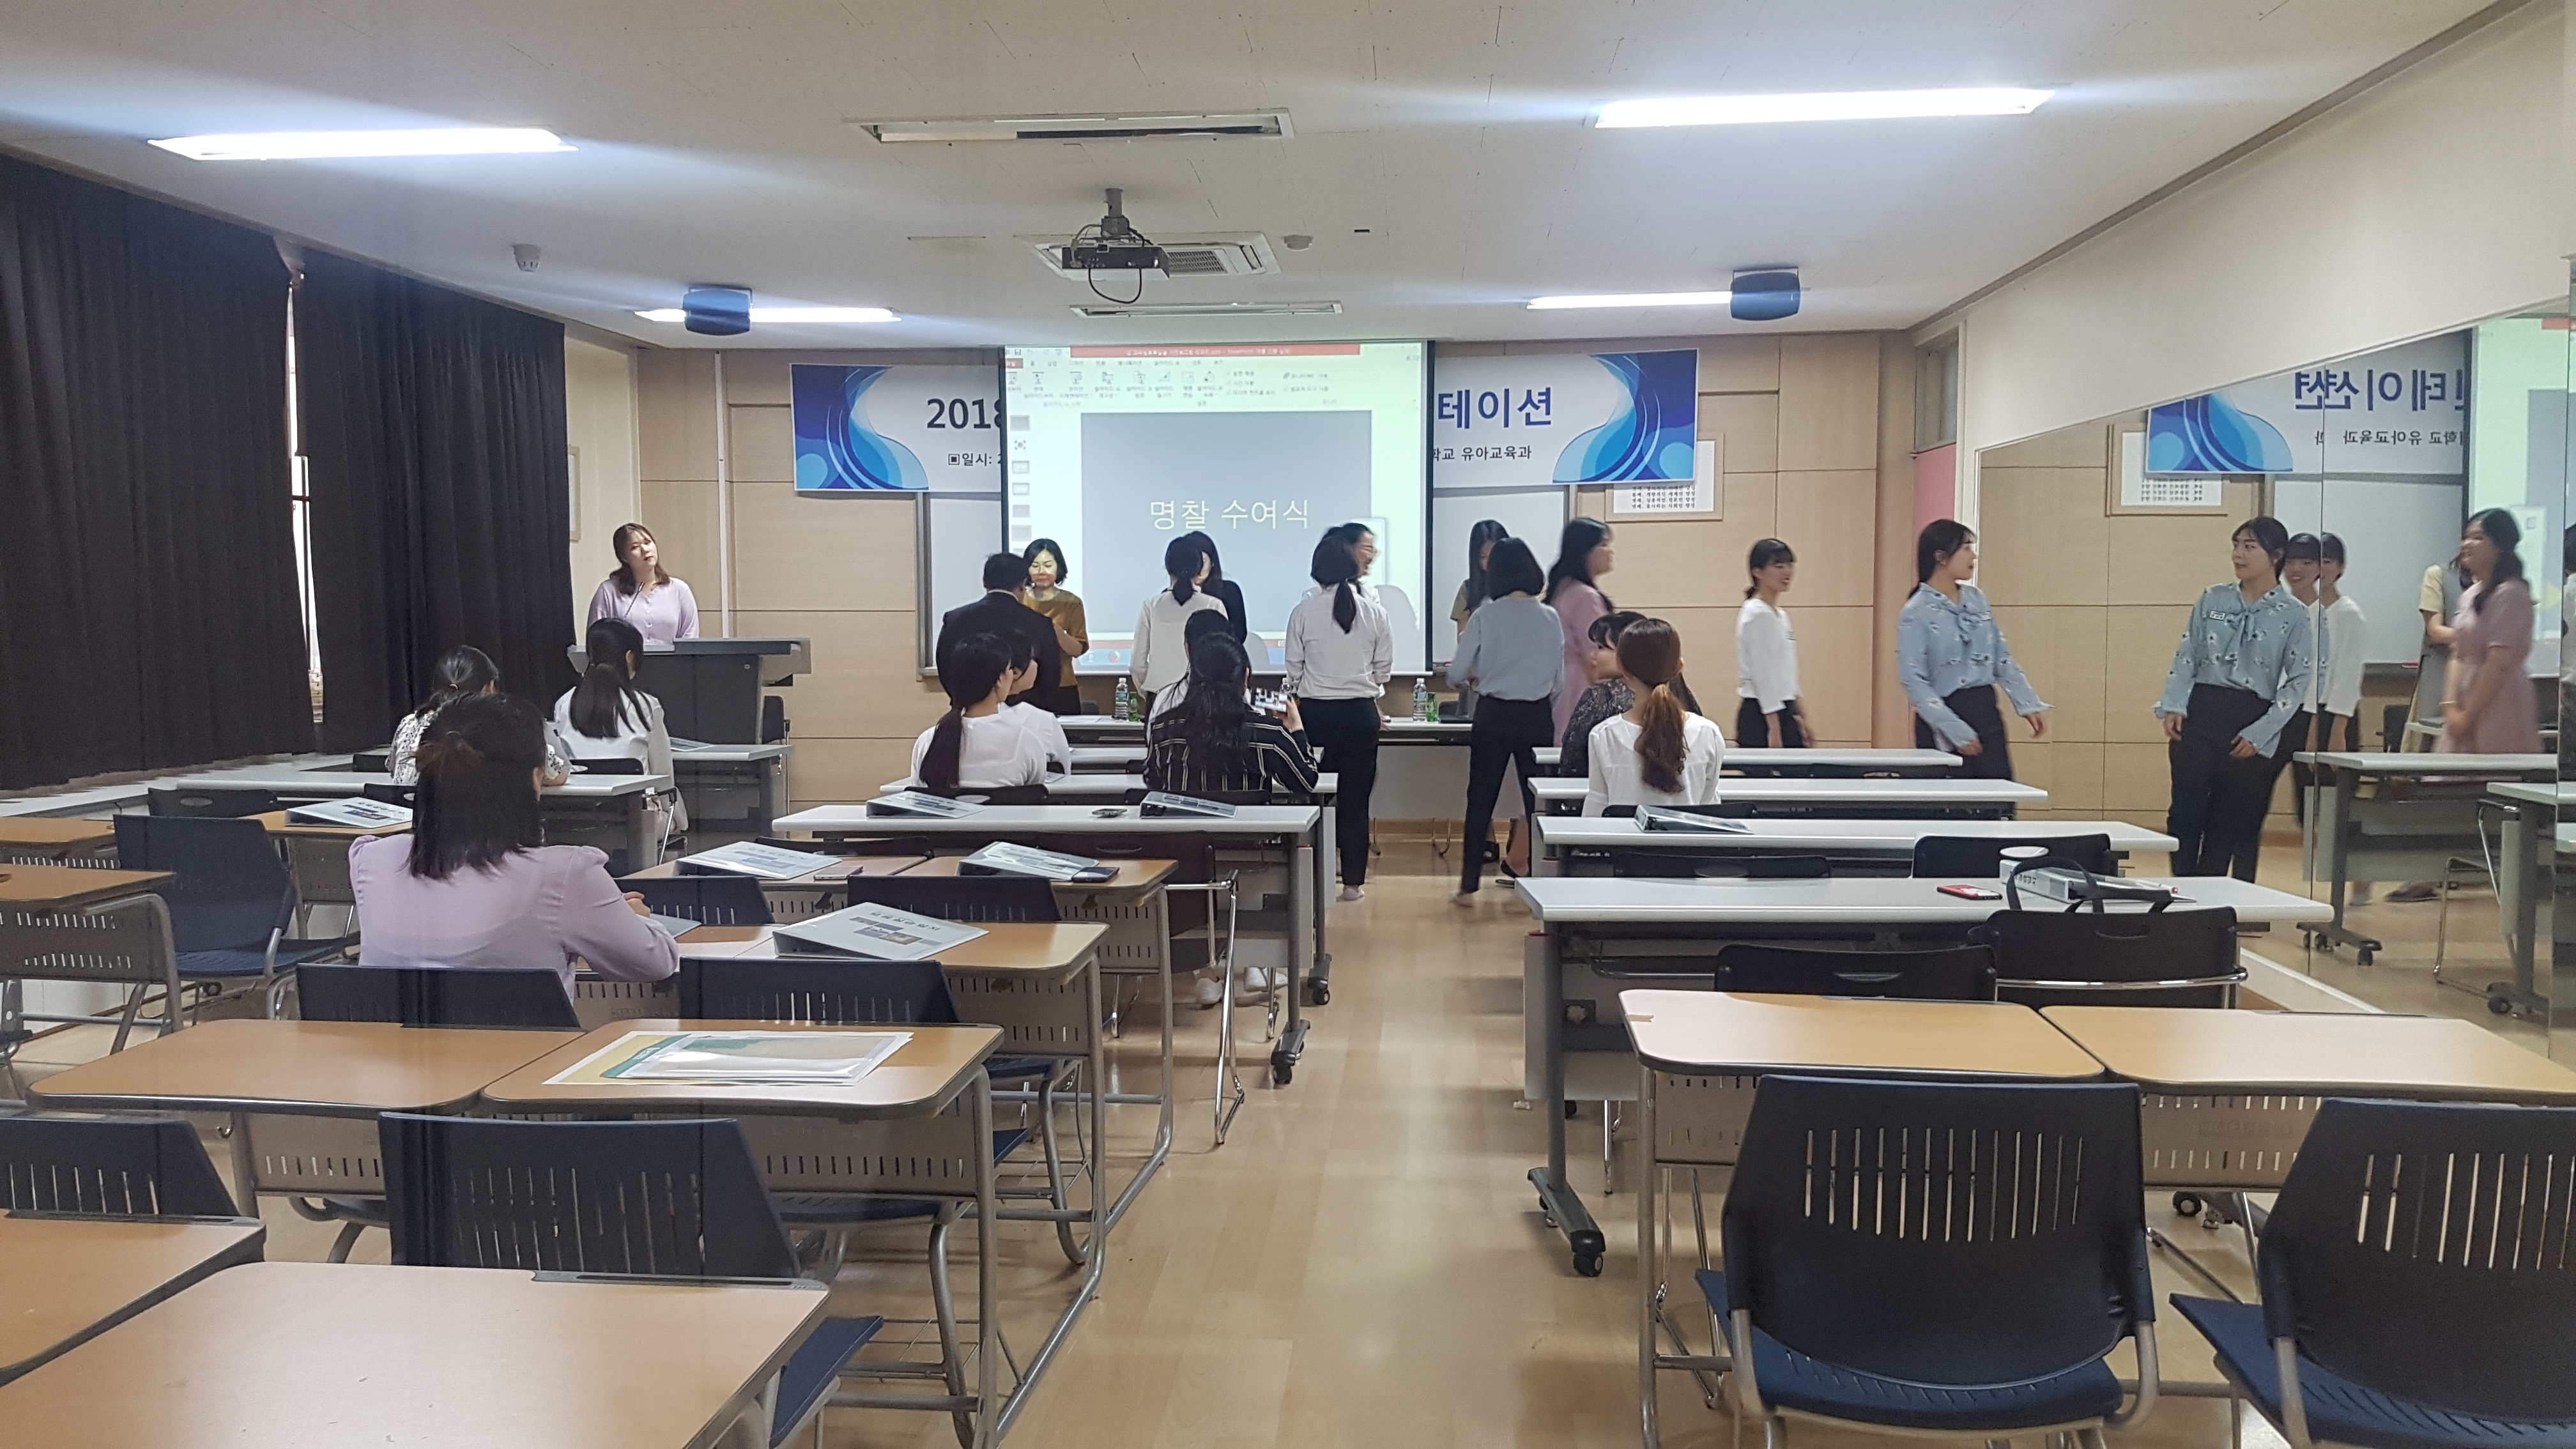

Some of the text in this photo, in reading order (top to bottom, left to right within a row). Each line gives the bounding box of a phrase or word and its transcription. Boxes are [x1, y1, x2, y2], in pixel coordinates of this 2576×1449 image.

[1438, 387, 1551, 429] 테이션
[1461, 445, 1532, 461] 유아교육과
[1150, 500, 1308, 530] 명찰 수여식
